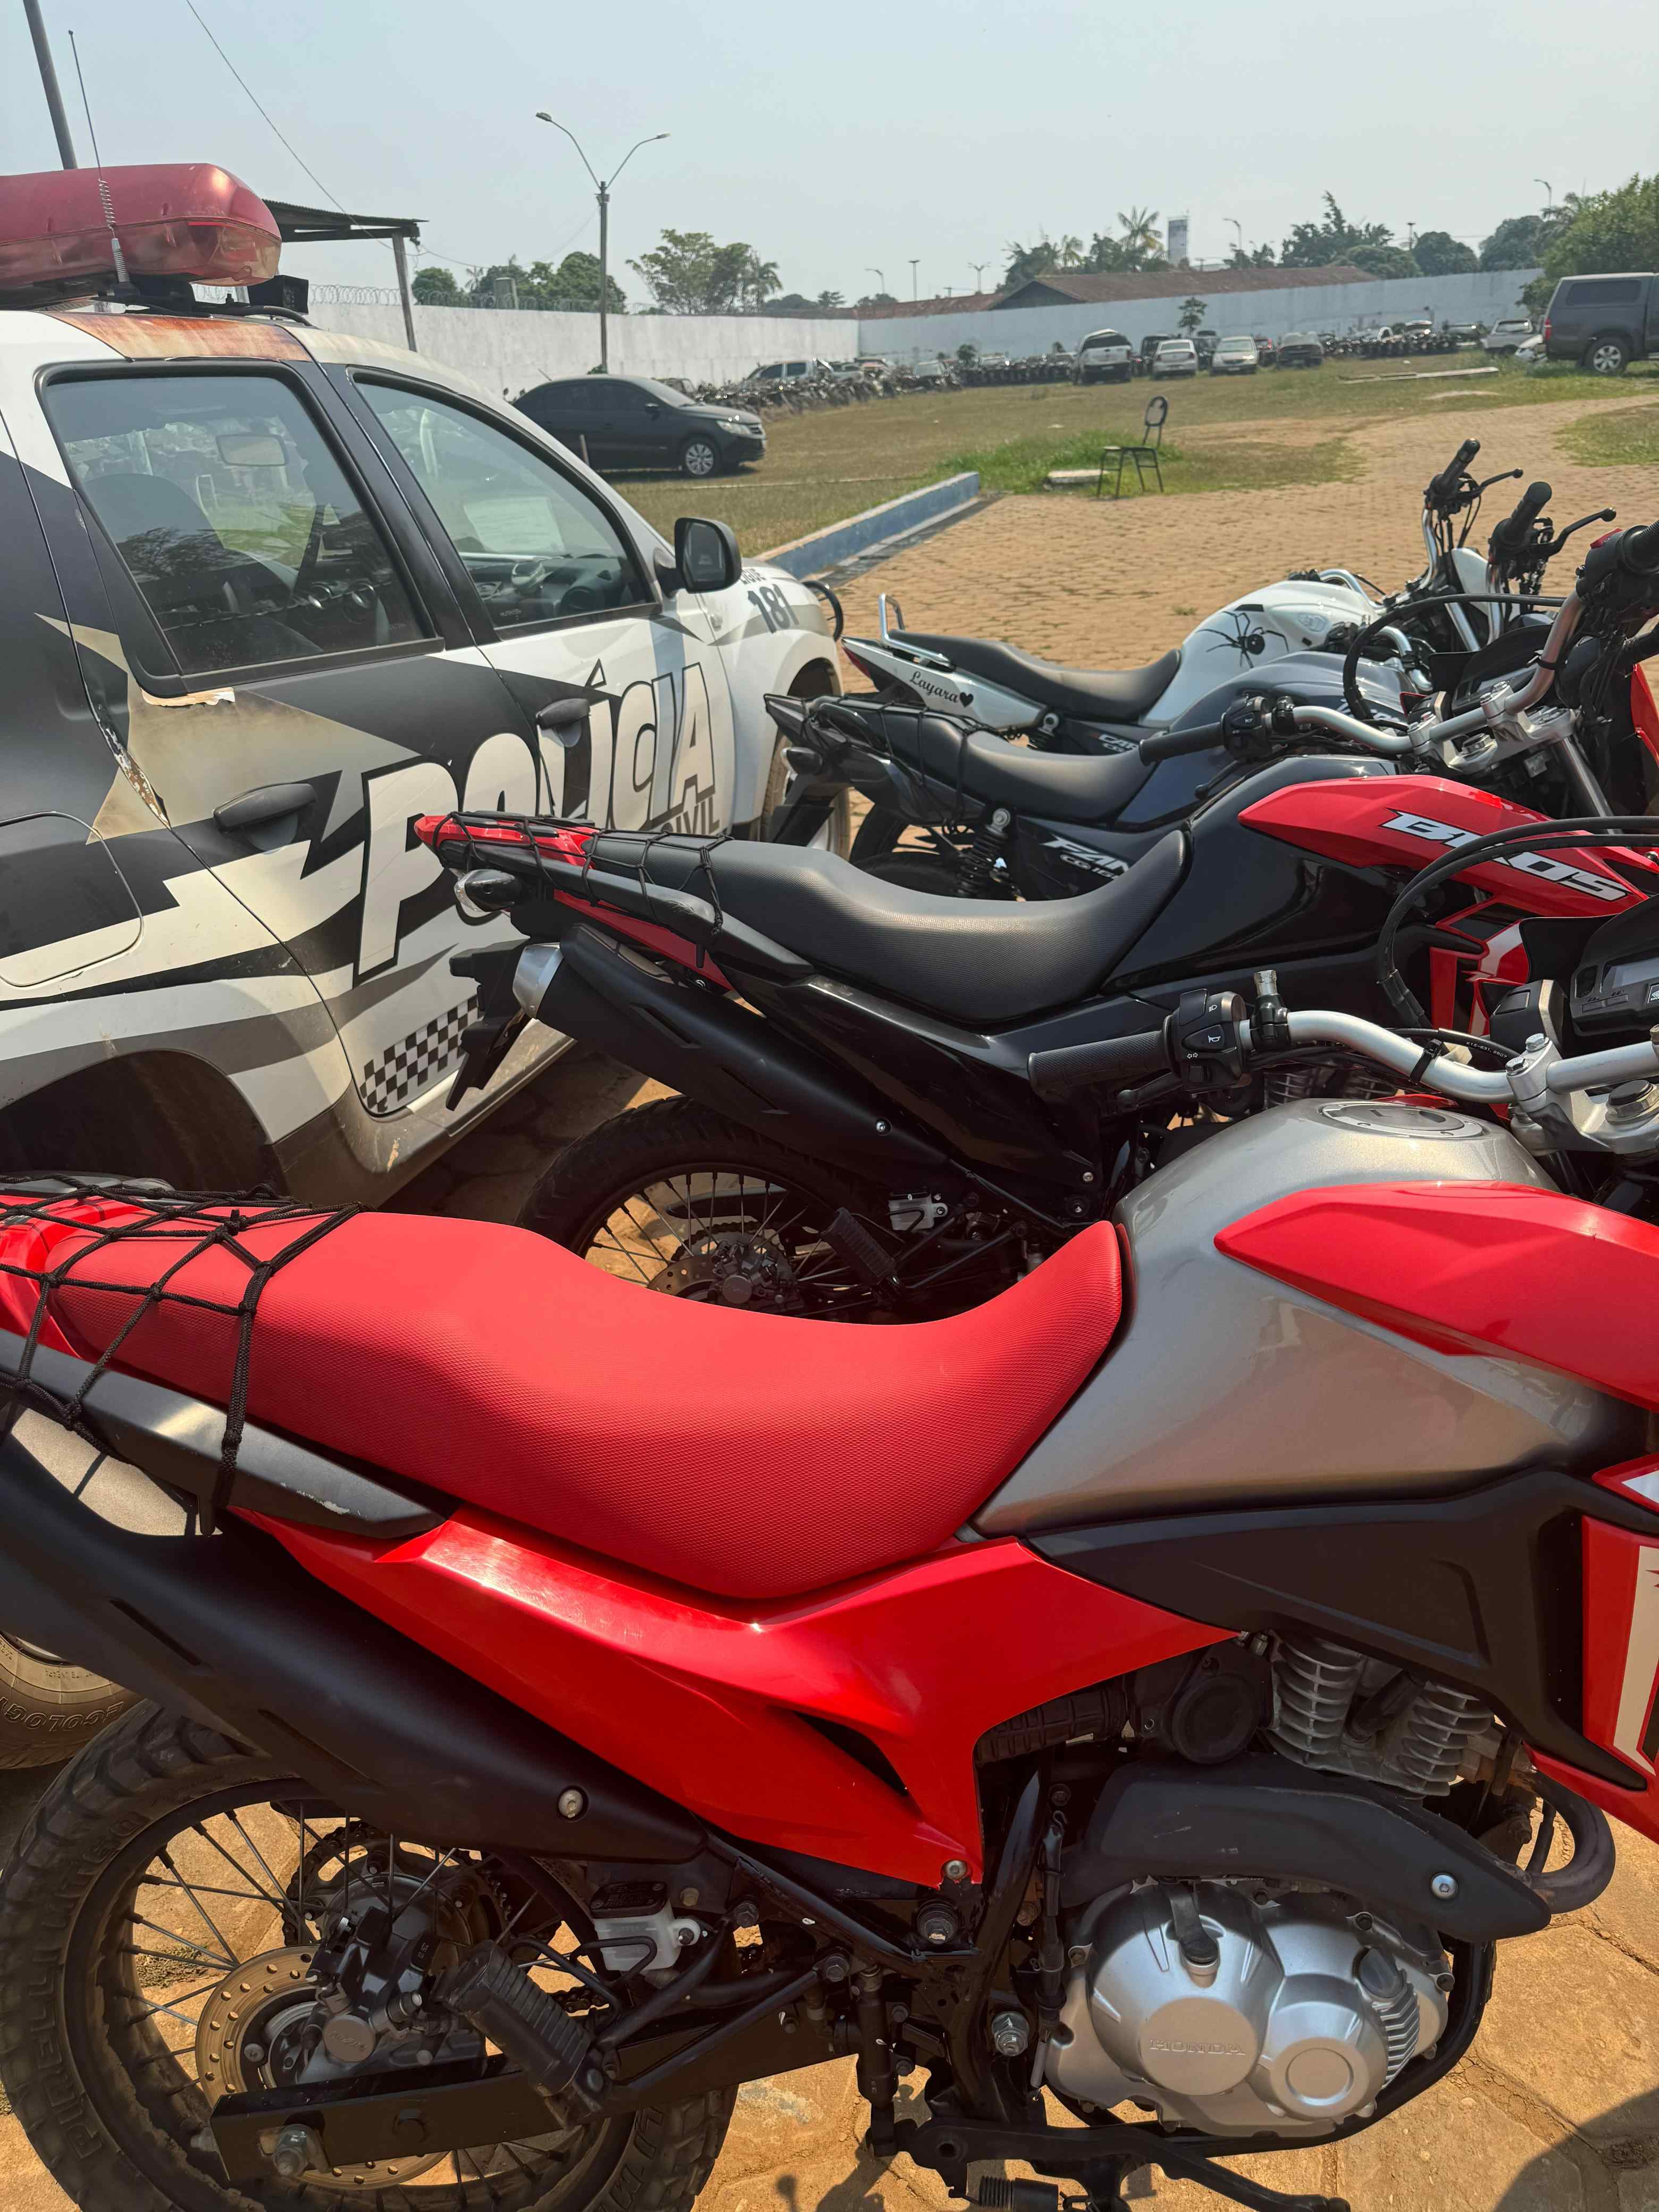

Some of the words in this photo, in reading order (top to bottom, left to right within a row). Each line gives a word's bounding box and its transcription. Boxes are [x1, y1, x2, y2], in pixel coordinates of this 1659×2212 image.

[748, 584, 799, 634] 181
[910, 671, 959, 703] Layara
[1091, 867, 1119, 878] 16
[29, 1946, 103, 2160] PIRELLI
[1150, 2039, 1246, 2055] HONDA
